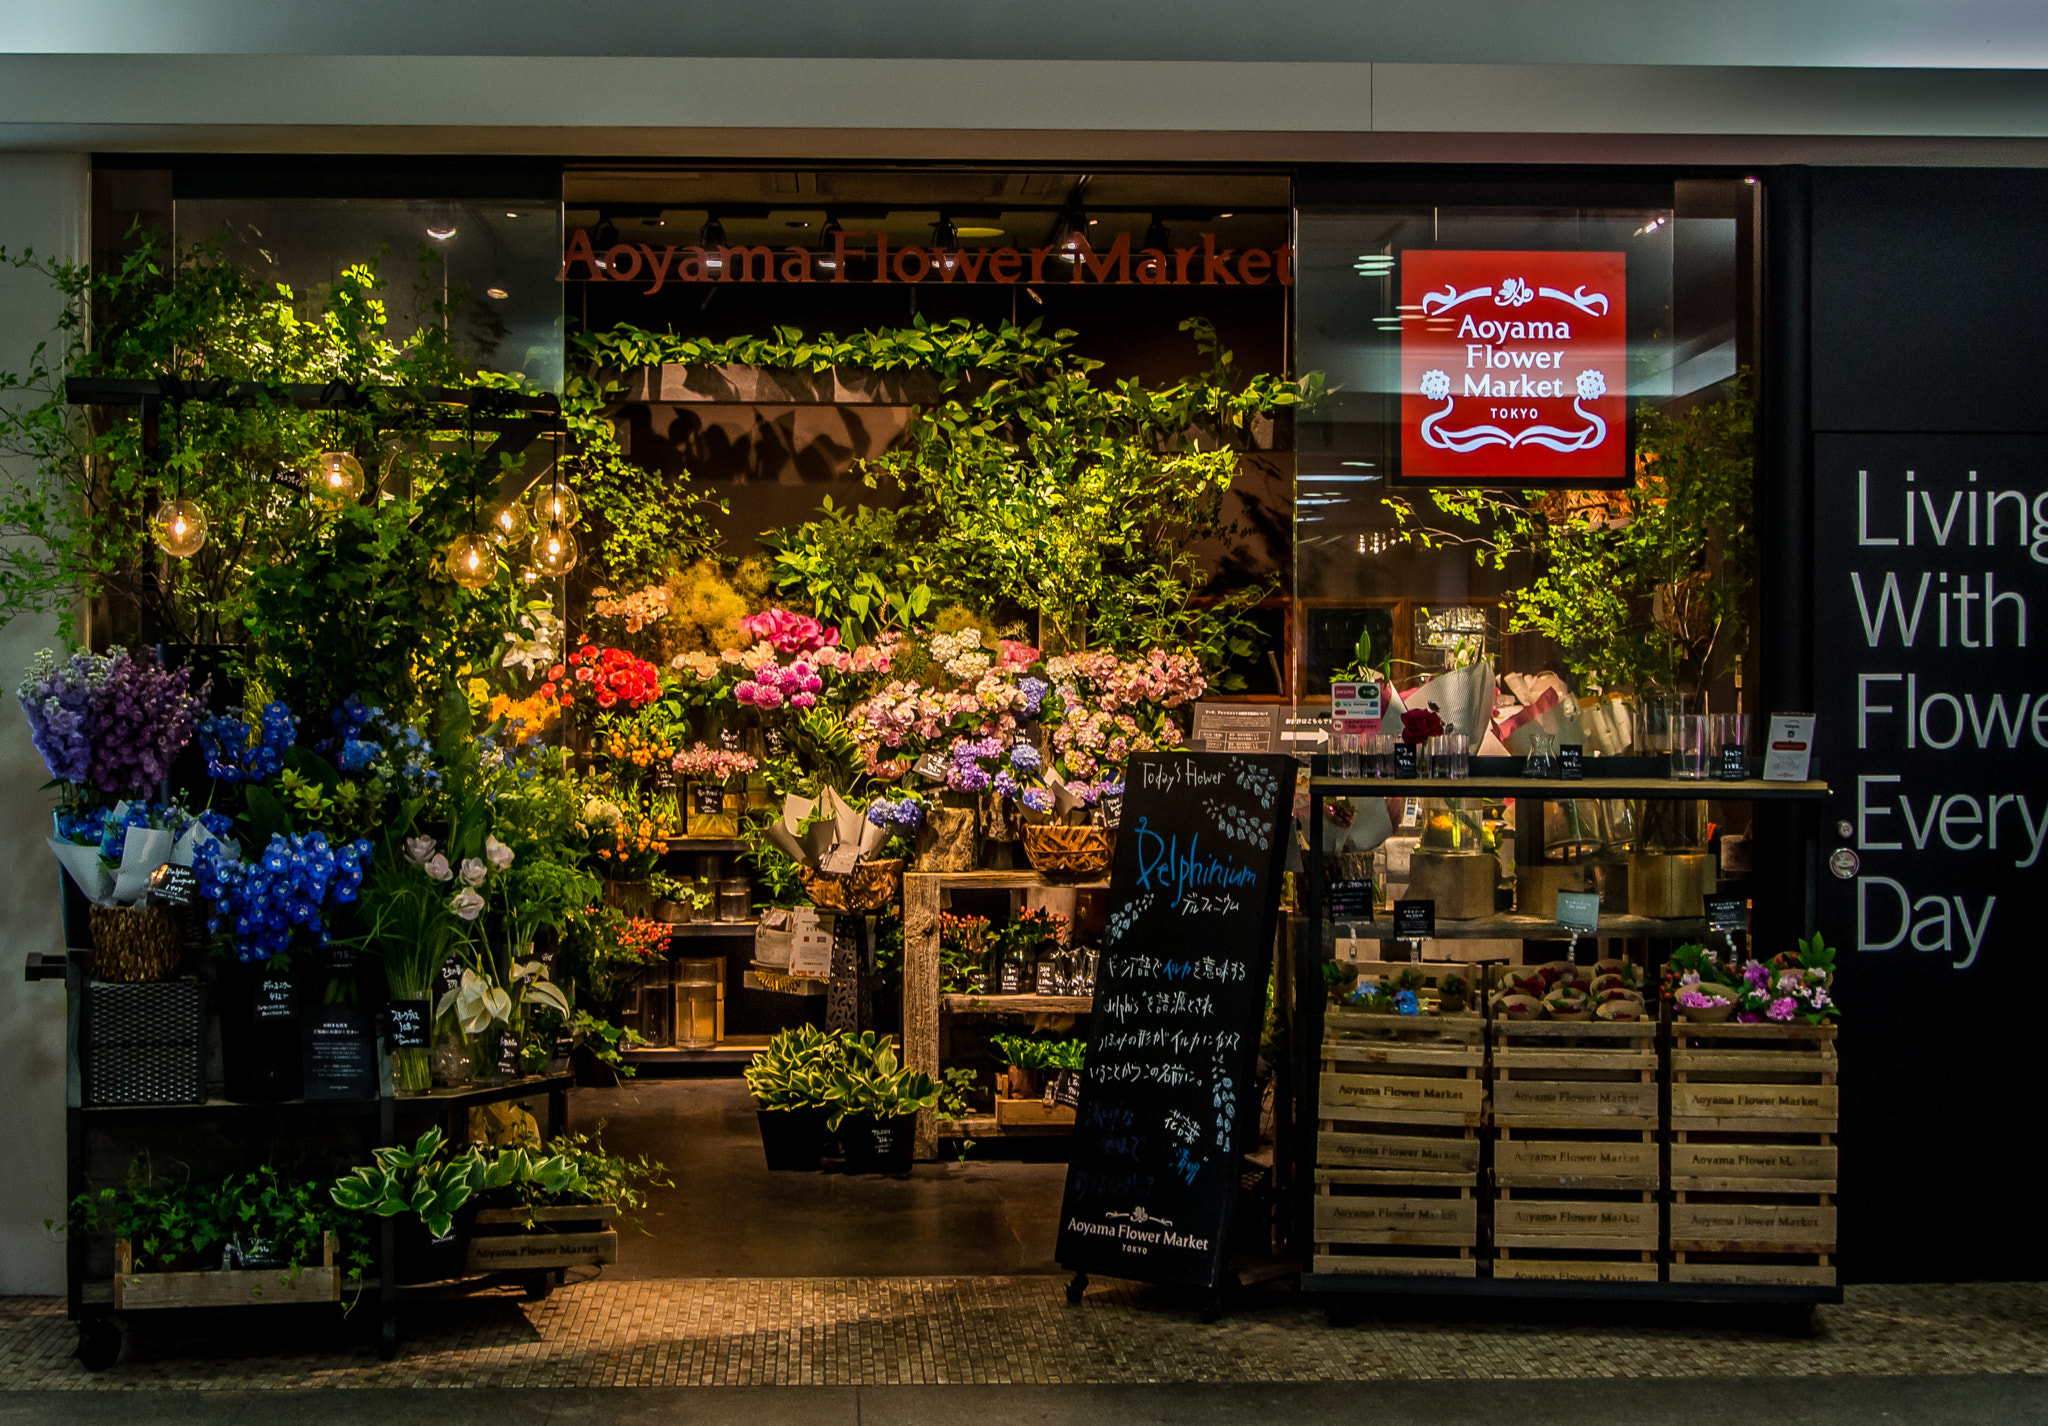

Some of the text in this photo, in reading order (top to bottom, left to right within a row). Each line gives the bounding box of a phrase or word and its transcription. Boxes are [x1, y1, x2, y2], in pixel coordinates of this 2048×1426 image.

[555, 229, 1294, 295] Aoyama Flower Market
[1457, 314, 1571, 345] Aoyama
[1466, 344, 1564, 369] Flower
[1463, 373, 1564, 398] Market
[1490, 408, 1538, 419] TOKYO
[1851, 572, 2027, 648] With
[1141, 758, 1226, 793] Today's Flower
[1858, 775, 2048, 868] Every
[1135, 816, 1256, 909] Delphinium
[1858, 876, 1996, 969] Day
[1339, 1085, 1463, 1099] Aoyama Flower Market
[1514, 1091, 1639, 1103] Aoyama Flower Market
[1692, 1095, 1819, 1107] Aoyama Flower Market
[1337, 1144, 1378, 1157] Aoyama
[1381, 1145, 1418, 1157] Flower
[1559, 1152, 1597, 1162] Flower
[1600, 1153, 1640, 1163] Market
[1692, 1154, 1735, 1166] Aoyama
[1738, 1155, 1776, 1166] Flower
[1334, 1207, 1375, 1219] Aoyama
[1378, 1208, 1415, 1219] Flower
[1514, 1211, 1640, 1224] Aoyama Flower Market
[1691, 1215, 1819, 1227] Aoyama Flower Market
[1067, 1217, 1209, 1251] Aoyama Flower Market
[476, 1244, 599, 1259] Aoyama Flower Market
[1122, 1243, 1147, 1255] TOKYO
